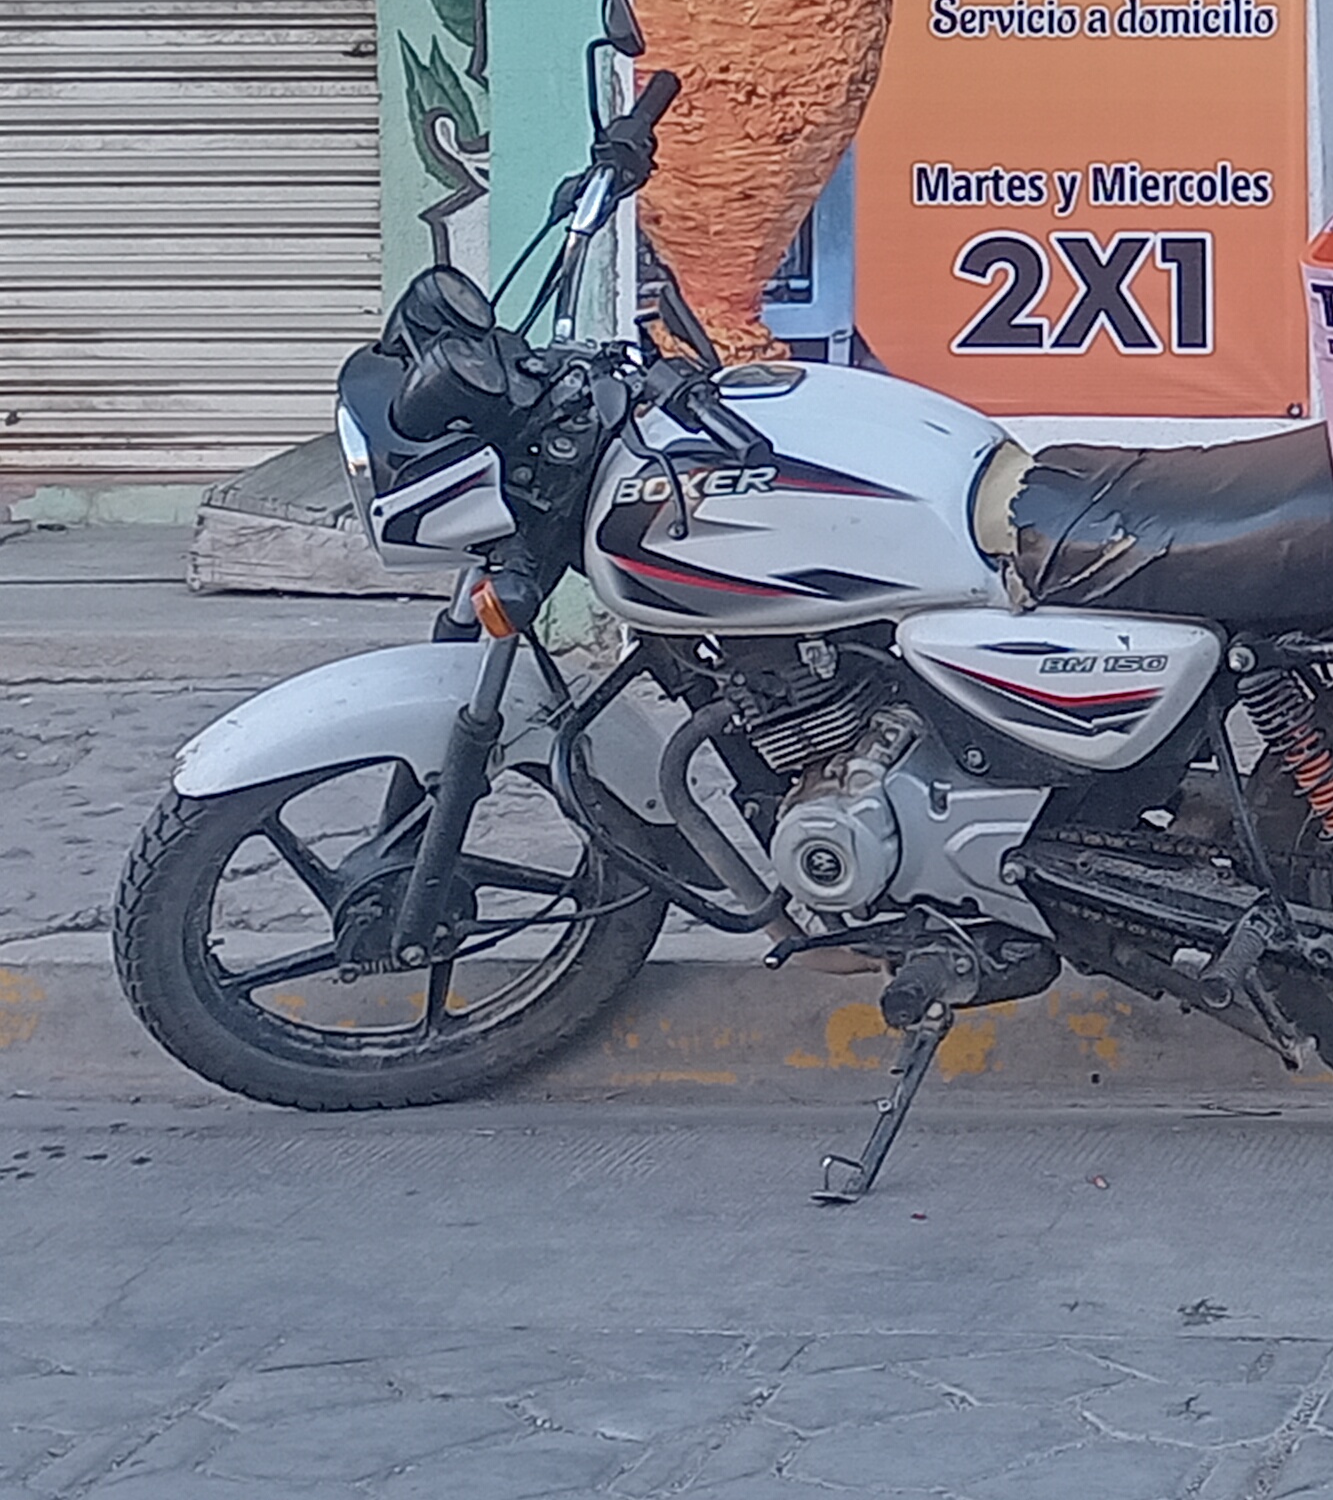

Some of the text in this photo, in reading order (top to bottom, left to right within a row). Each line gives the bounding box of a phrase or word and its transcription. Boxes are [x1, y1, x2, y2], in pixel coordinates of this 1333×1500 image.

[1087, 6, 1108, 34] a
[915, 164, 1270, 214] Martes y Miercoles
[955, 236, 1209, 350] 2X1
[614, 467, 778, 505] BOXER
[1040, 655, 1168, 674] BM 150
